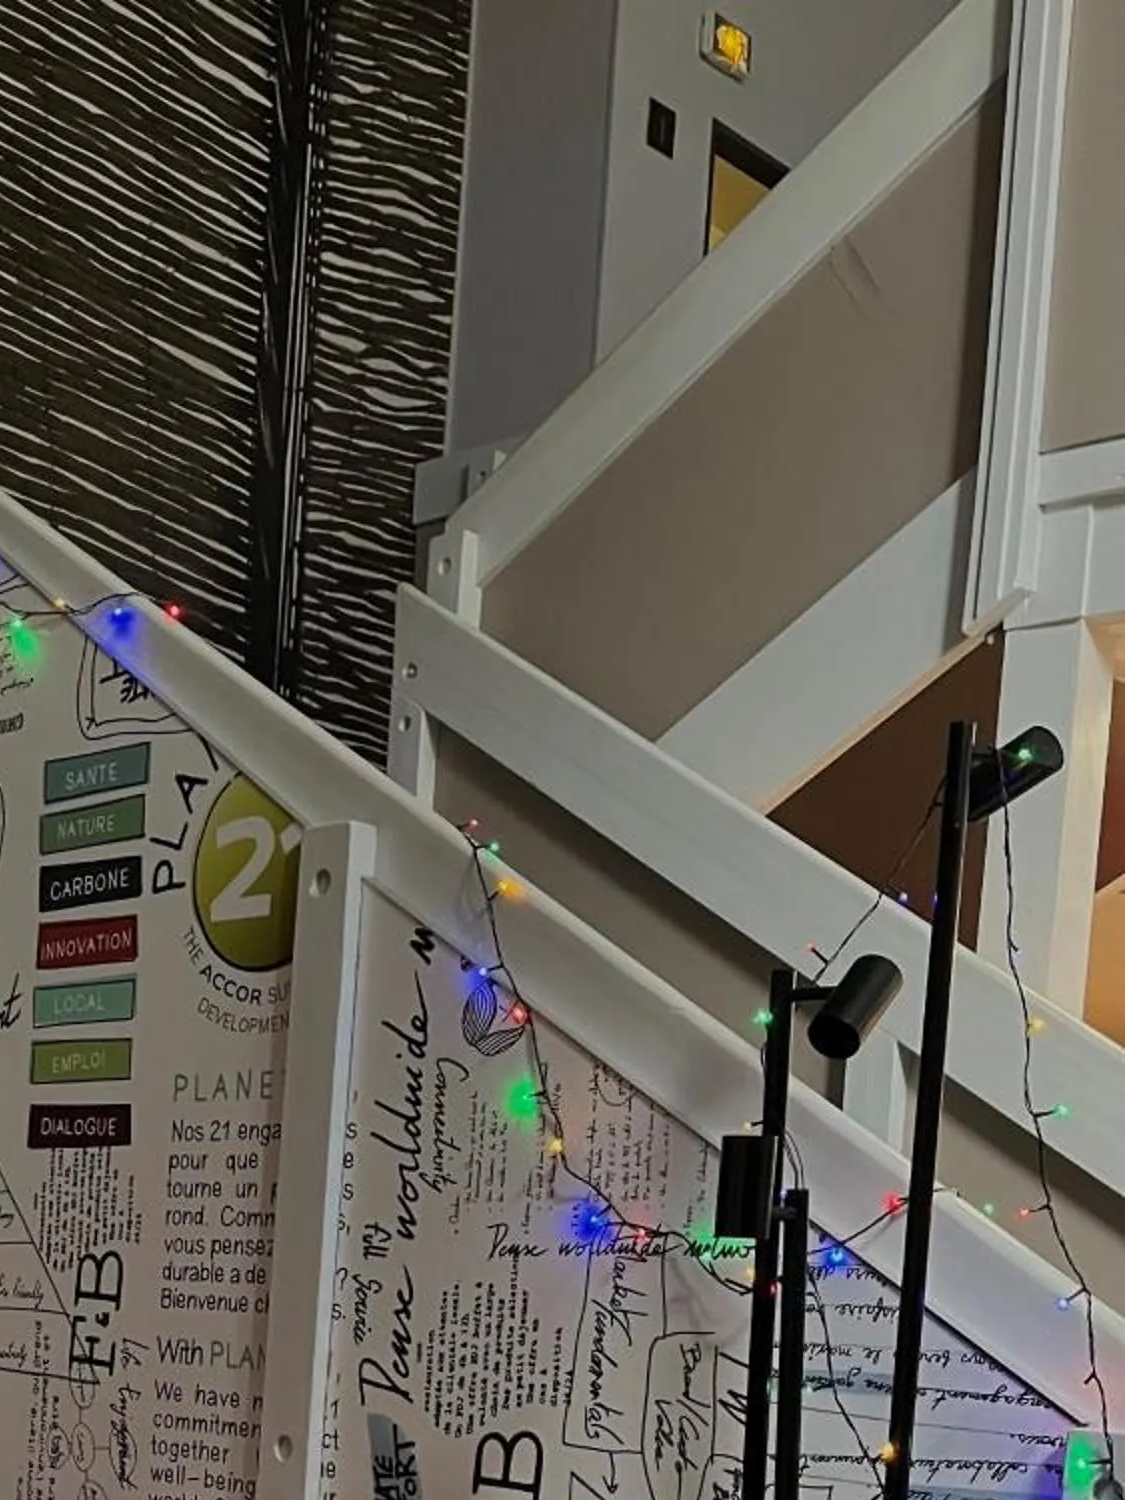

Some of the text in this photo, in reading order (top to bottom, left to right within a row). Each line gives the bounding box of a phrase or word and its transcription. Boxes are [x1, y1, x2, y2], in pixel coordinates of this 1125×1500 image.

[57, 813, 116, 838] NATURE
[50, 867, 129, 901] CARBONE
[40, 928, 133, 962] INNOVATION
[182, 925, 204, 966] THE
[199, 962, 264, 1006] ACCOR
[53, 986, 106, 1014] LOCAL
[52, 1050, 106, 1074] EMPLOI
[174, 1071, 274, 1102] PLANE
[370, 973, 430, 1240] worldwide
[40, 1115, 117, 1137] DIALOGUE
[172, 1120, 282, 1149] Nos 21 enga
[169, 1153, 259, 1174] pour que
[166, 1181, 258, 1199] tourne un
[165, 1206, 210, 1228] rond.
[164, 1237, 274, 1261] vous pensez
[162, 1262, 224, 1284] durable
[245, 1264, 266, 1285] de
[160, 1290, 249, 1313] Bienvenue
[156, 1335, 205, 1367] With
[154, 1379, 241, 1406] We have
[153, 1411, 263, 1438] commitmen
[151, 1435, 231, 1466] together
